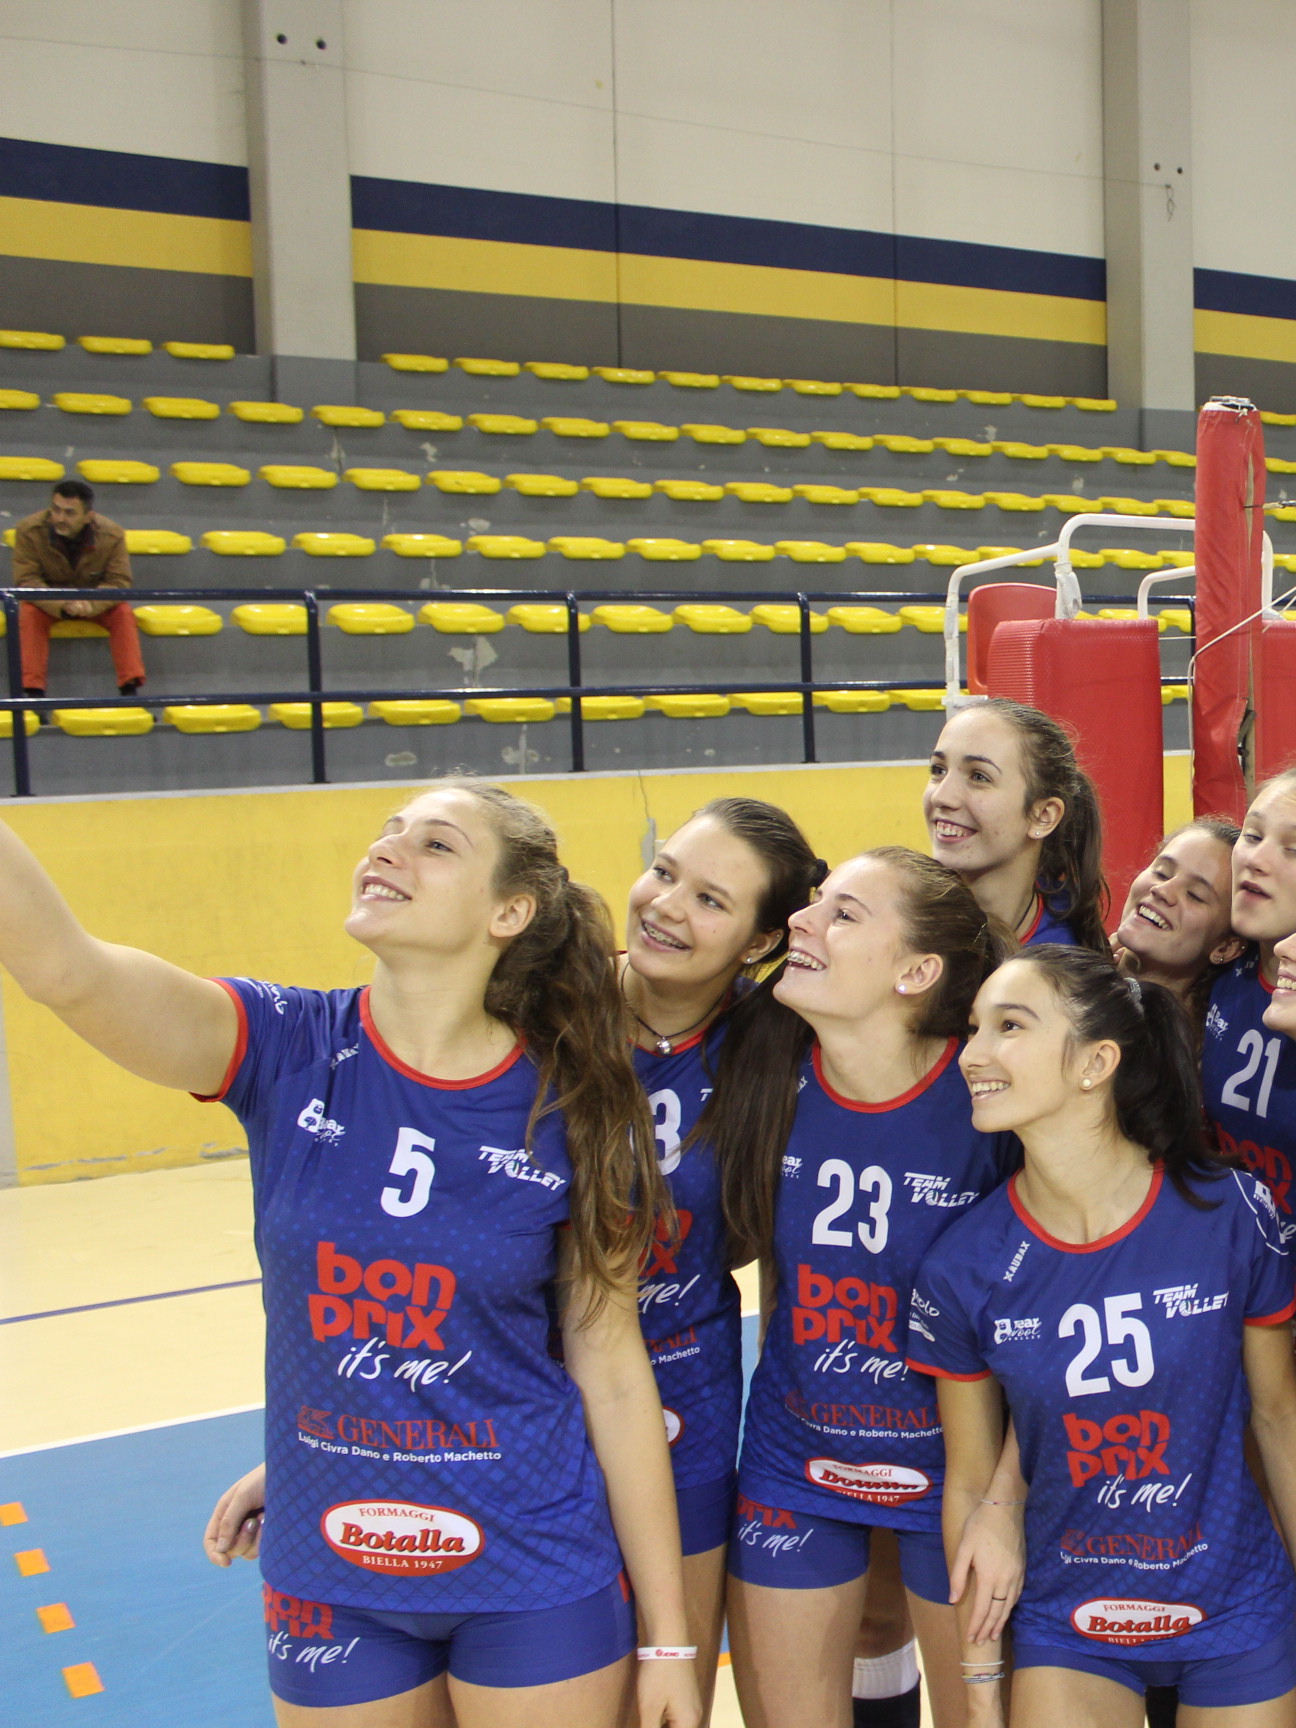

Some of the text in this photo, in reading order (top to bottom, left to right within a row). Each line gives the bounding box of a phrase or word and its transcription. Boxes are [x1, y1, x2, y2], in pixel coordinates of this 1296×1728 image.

[1221, 1029, 1281, 1118] 21
[380, 1127, 436, 1217] 5
[478, 1145, 533, 1164] TEAM
[487, 1160, 566, 1190] VOLLEY
[903, 1172, 952, 1191] TEAM
[812, 1159, 893, 1254] 23
[910, 1189, 980, 1208] VOLLEY
[316, 1241, 457, 1313] bon
[1003, 1240, 1031, 1283] XAUDAX
[797, 1264, 897, 1321] bon
[1152, 1283, 1201, 1305] TEAM
[307, 1294, 449, 1351] prix
[792, 1306, 897, 1352] prix
[658, 1346, 700, 1365] Machetto
[813, 1339, 909, 1385] it's me!
[1058, 1292, 1155, 1398] 25
[336, 1337, 472, 1393] it's me!
[298, 1431, 502, 1463] Luigi Civra Dano e Roberto Machetto
[337, 1414, 500, 1451] GENERALI
[823, 1425, 848, 1436] Dano
[859, 1430, 898, 1439] Roberto
[1062, 1410, 1171, 1452] bon
[1066, 1441, 1171, 1488] prix
[877, 1495, 900, 1503] 1947
[1097, 1472, 1193, 1512] it's me!
[359, 1507, 436, 1523] FORMAGGI
[340, 1522, 466, 1554] Botalla
[738, 1520, 814, 1558] it's me!
[1101, 1557, 1127, 1565] Dano
[1129, 1558, 1133, 1566] e
[1133, 1560, 1171, 1570] Roberto
[1173, 1543, 1208, 1568] Machetto
[362, 1555, 445, 1570] BIELLA 1947
[1087, 1615, 1193, 1633] Botalla
[1103, 1604, 1166, 1612] FORMAGGI
[268, 1631, 361, 1673] it's me!
